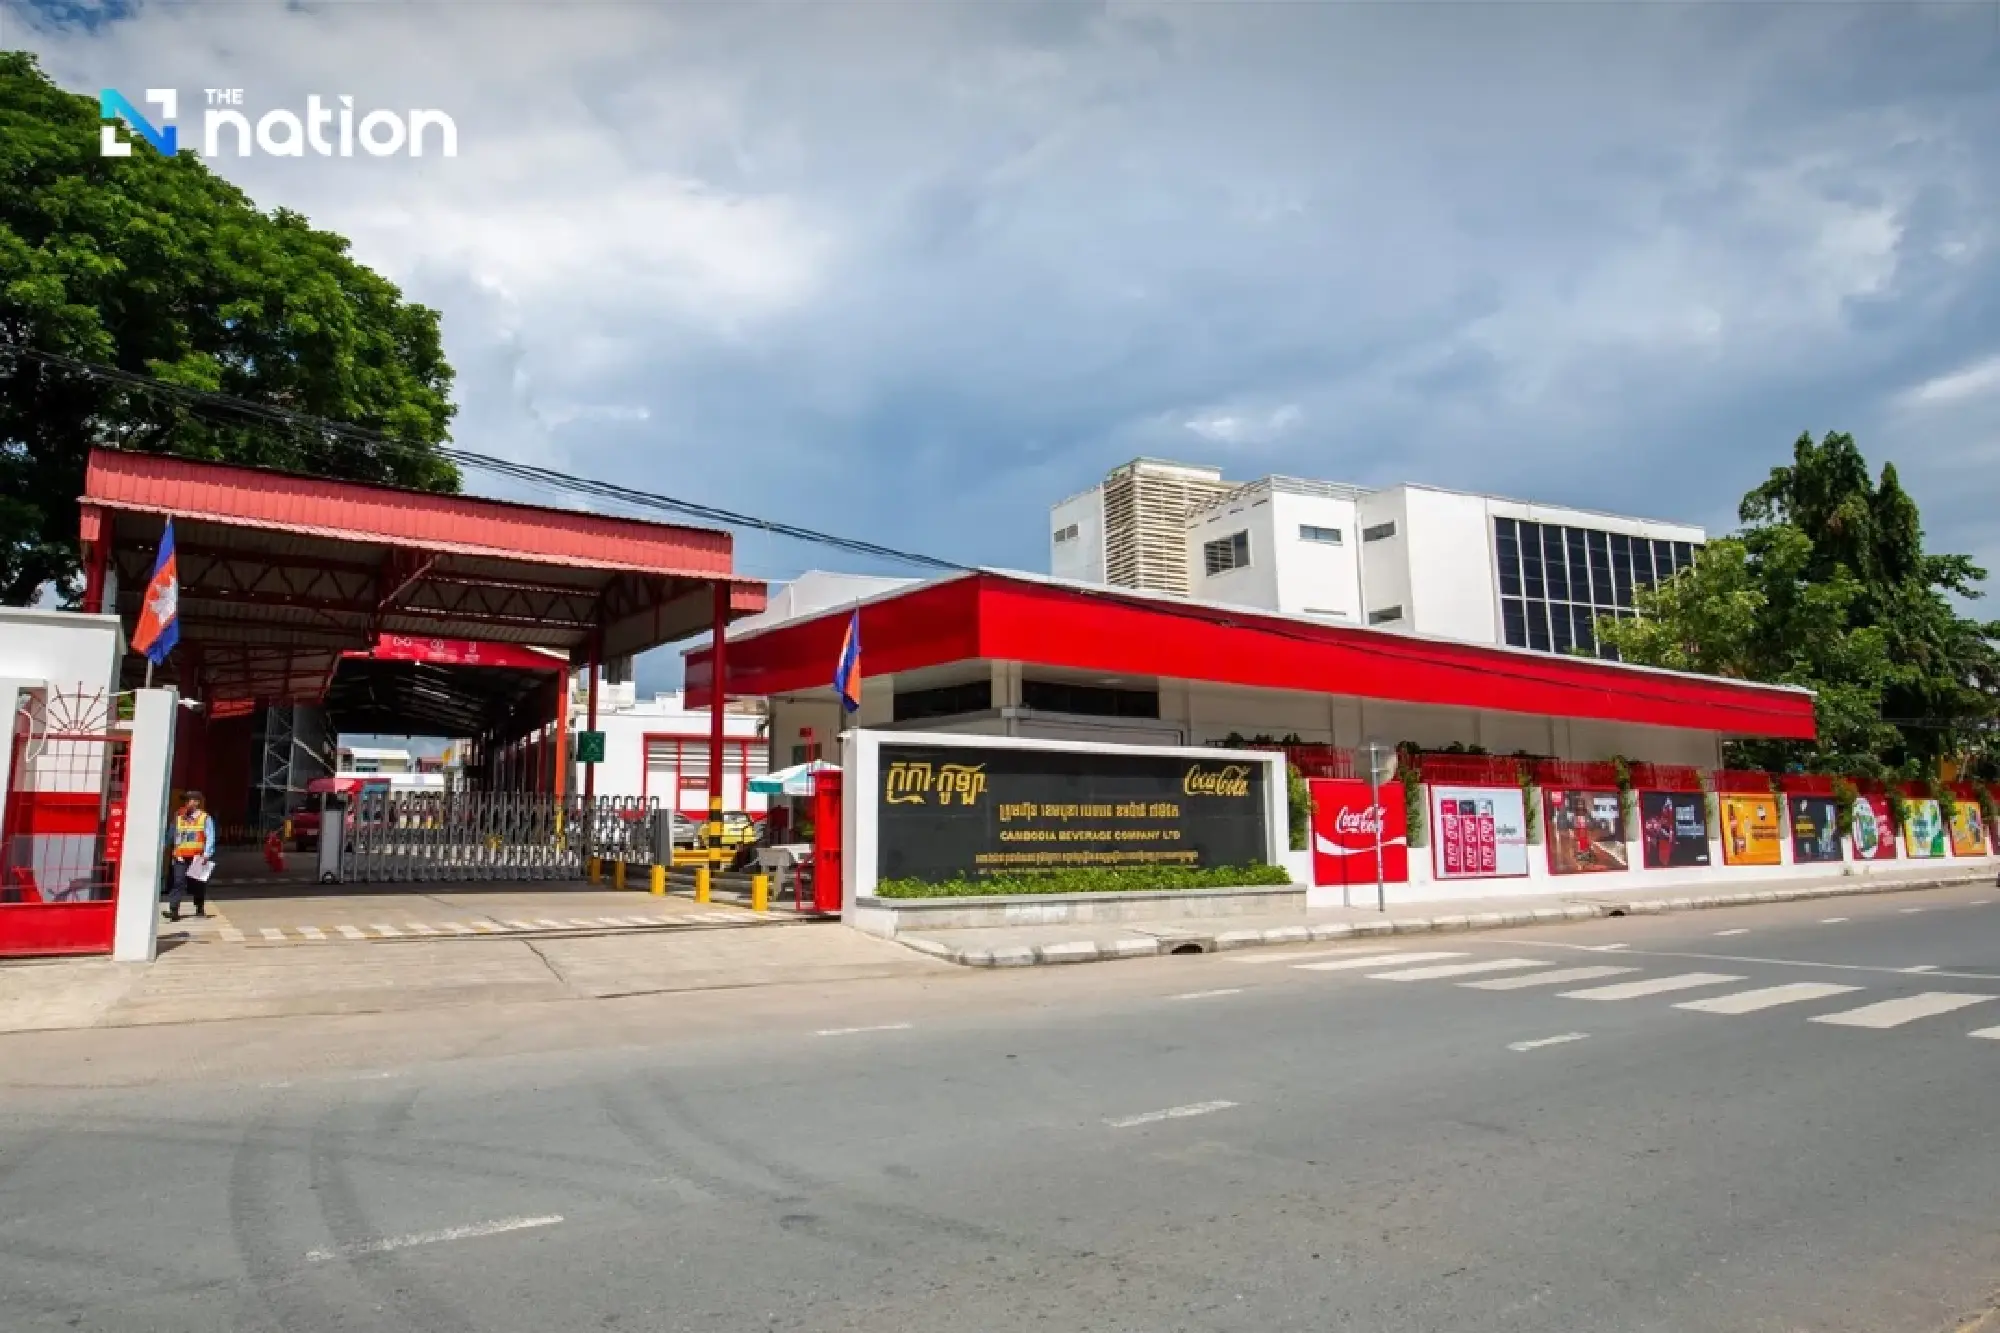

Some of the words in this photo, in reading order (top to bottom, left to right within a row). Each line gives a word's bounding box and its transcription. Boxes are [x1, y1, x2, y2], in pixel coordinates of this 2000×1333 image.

[1184, 764, 1250, 796] Coca-Cola
[1000, 830, 1057, 842] CAMBODIA
[1058, 830, 1112, 841] BEVERAGE
[1114, 830, 1161, 841] COMPANY
[1162, 830, 1181, 841] LTD
